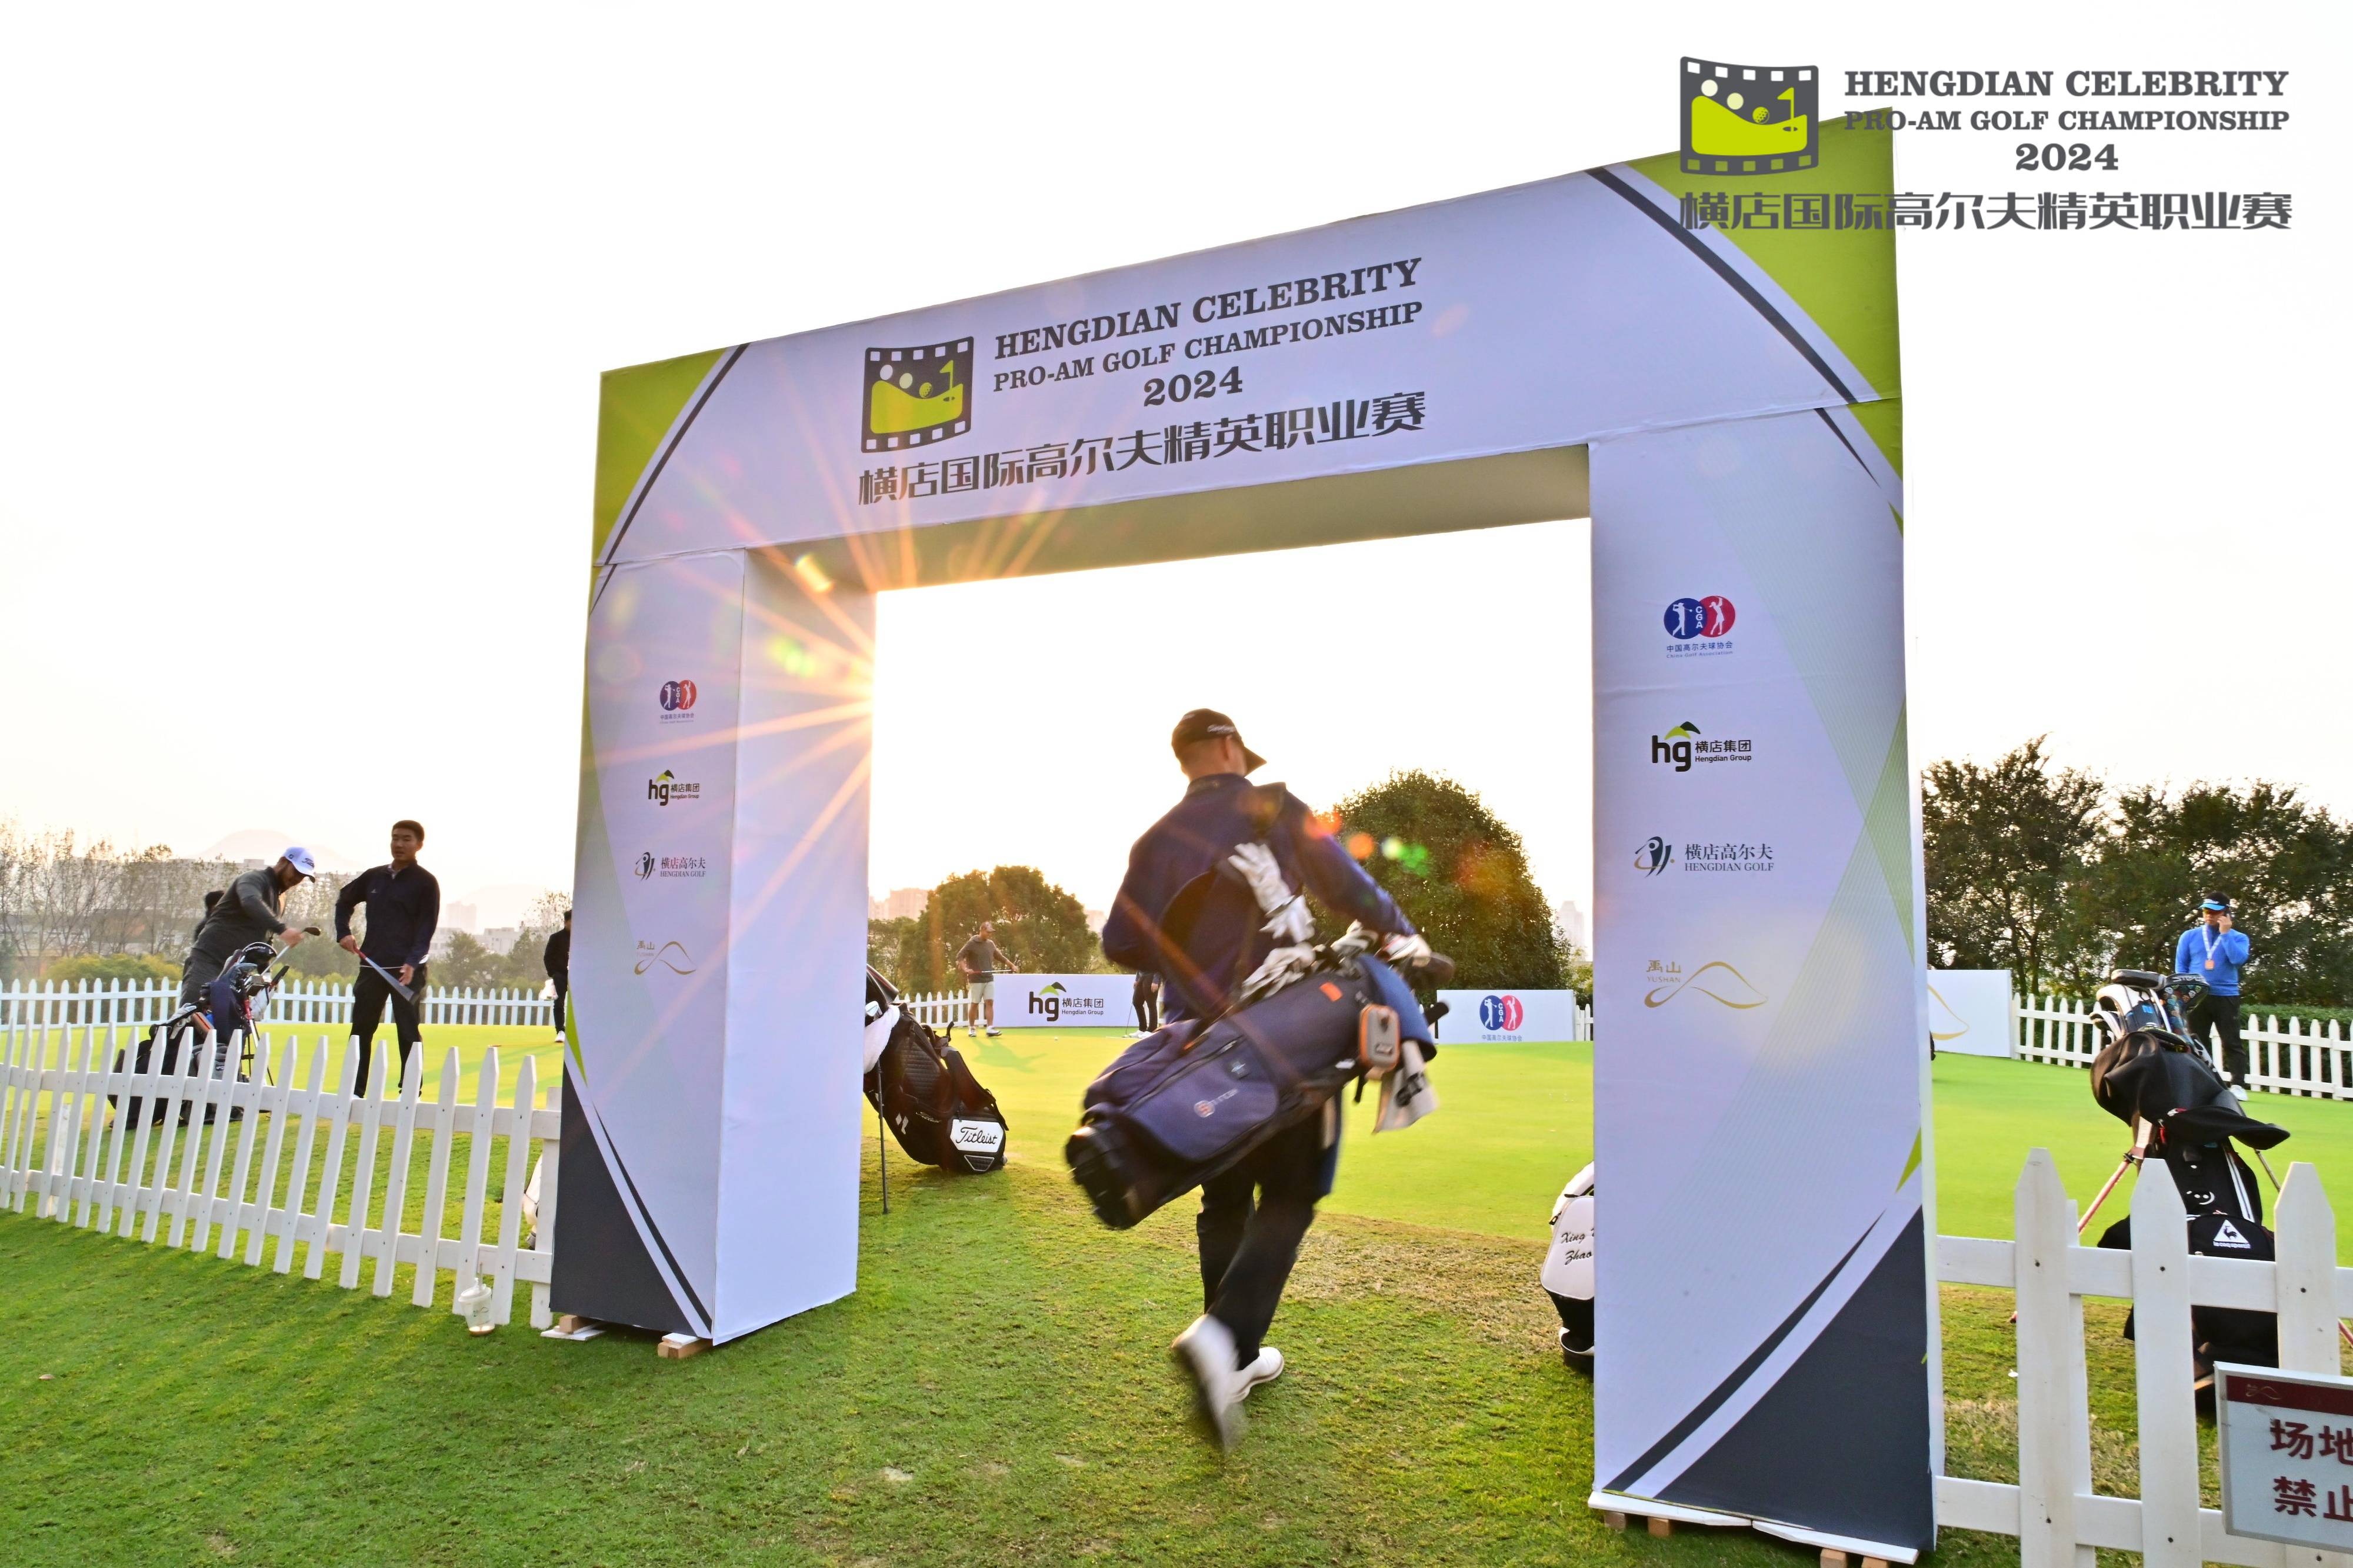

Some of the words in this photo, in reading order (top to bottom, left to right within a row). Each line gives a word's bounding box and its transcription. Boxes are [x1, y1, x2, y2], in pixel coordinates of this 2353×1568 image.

[995, 303, 1181, 360] HENGDIAN
[1192, 258, 1422, 323] CELEBRITY
[994, 358, 1095, 392] PRO-AM
[1102, 343, 1178, 372] GOLF
[1184, 301, 1423, 359] CHAMPIONSHIP
[1144, 366, 1244, 407] 2024
[858, 391, 1427, 506] 横店国际高尔夫精英职业赛
[1695, 606, 1703, 629] CGA
[1667, 641, 1733, 652] 中国高尔夫球协会
[1652, 735, 1691, 772] hg
[1695, 739, 1751, 753] 横店集团
[1695, 755, 1727, 763] Hengdian
[1729, 754, 1752, 762] Group
[648, 779, 669, 806] hg
[671, 783, 699, 793] 横店集团
[1684, 843, 1774, 860] 横店高尔夫
[661, 857, 706, 869] 横店高尔夫
[1684, 862, 1741, 872] HENGDIAN
[1744, 862, 1774, 872] GOLF
[1029, 992, 1059, 1022] hg
[1062, 997, 1104, 1008] 横店集团
[956, 1126, 999, 1145] Titleist
[1561, 1232, 1585, 1245] Xing
[1565, 1249, 1592, 1265] Zhao
[2269, 1419, 2353, 1466] 场地
[2273, 1476, 2353, 1523] 禁止
